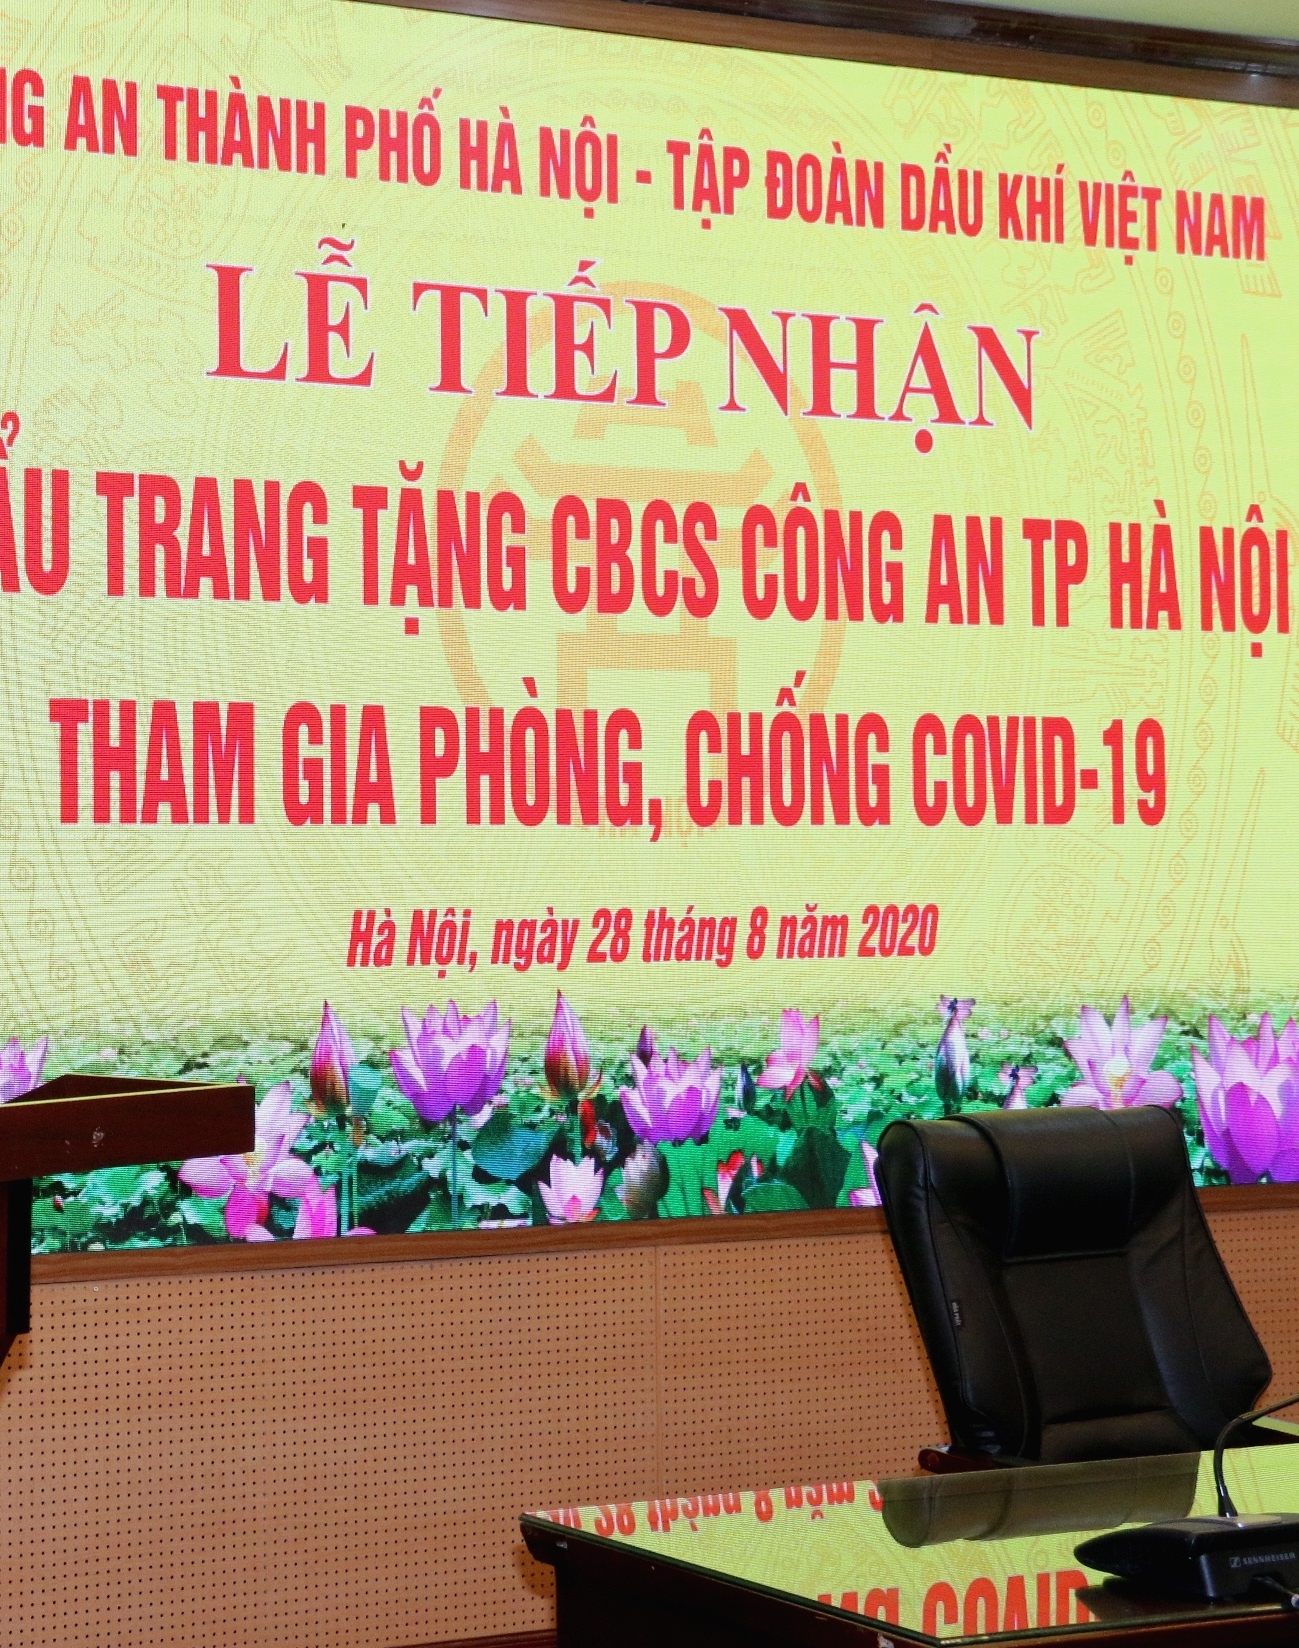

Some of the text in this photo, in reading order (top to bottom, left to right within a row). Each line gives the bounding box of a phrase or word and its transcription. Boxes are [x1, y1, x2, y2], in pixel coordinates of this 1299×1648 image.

[64, 76, 138, 157] AN
[156, 76, 326, 175] THÀNH
[345, 88, 441, 187] PHỐ
[459, 107, 523, 195] HÀ
[539, 115, 618, 218] NỘI
[636, 170, 652, 184] -
[667, 128, 750, 229] TẬP
[765, 142, 884, 228] ĐOÀN
[901, 144, 983, 237] DẦU
[998, 164, 1064, 244] KHÍ
[1079, 170, 1162, 265] VIỆT
[1176, 190, 1265, 260] NAM
[206, 237, 1039, 453] LỄ TIẾP NHẬN
[96, 471, 329, 604] TRANG
[352, 461, 527, 635] TẶNG
[551, 494, 719, 619] CBCS
[741, 482, 904, 624] CÔNG
[925, 514, 1004, 626] AN
[1022, 518, 1089, 628] TP
[1109, 499, 1182, 631] HÀ
[1199, 504, 1290, 658] NỘI
[49, 698, 255, 825] THAM
[282, 701, 396, 827] GIA
[419, 677, 663, 842] PHÒNG,
[685, 670, 891, 828] CHỐNG
[912, 713, 1166, 827] COVID-19
[347, 903, 939, 979] Hà Nội, ngày 28 tháng 8 năm 2020
[1242, 1552, 1296, 1566] SENNHEISER
